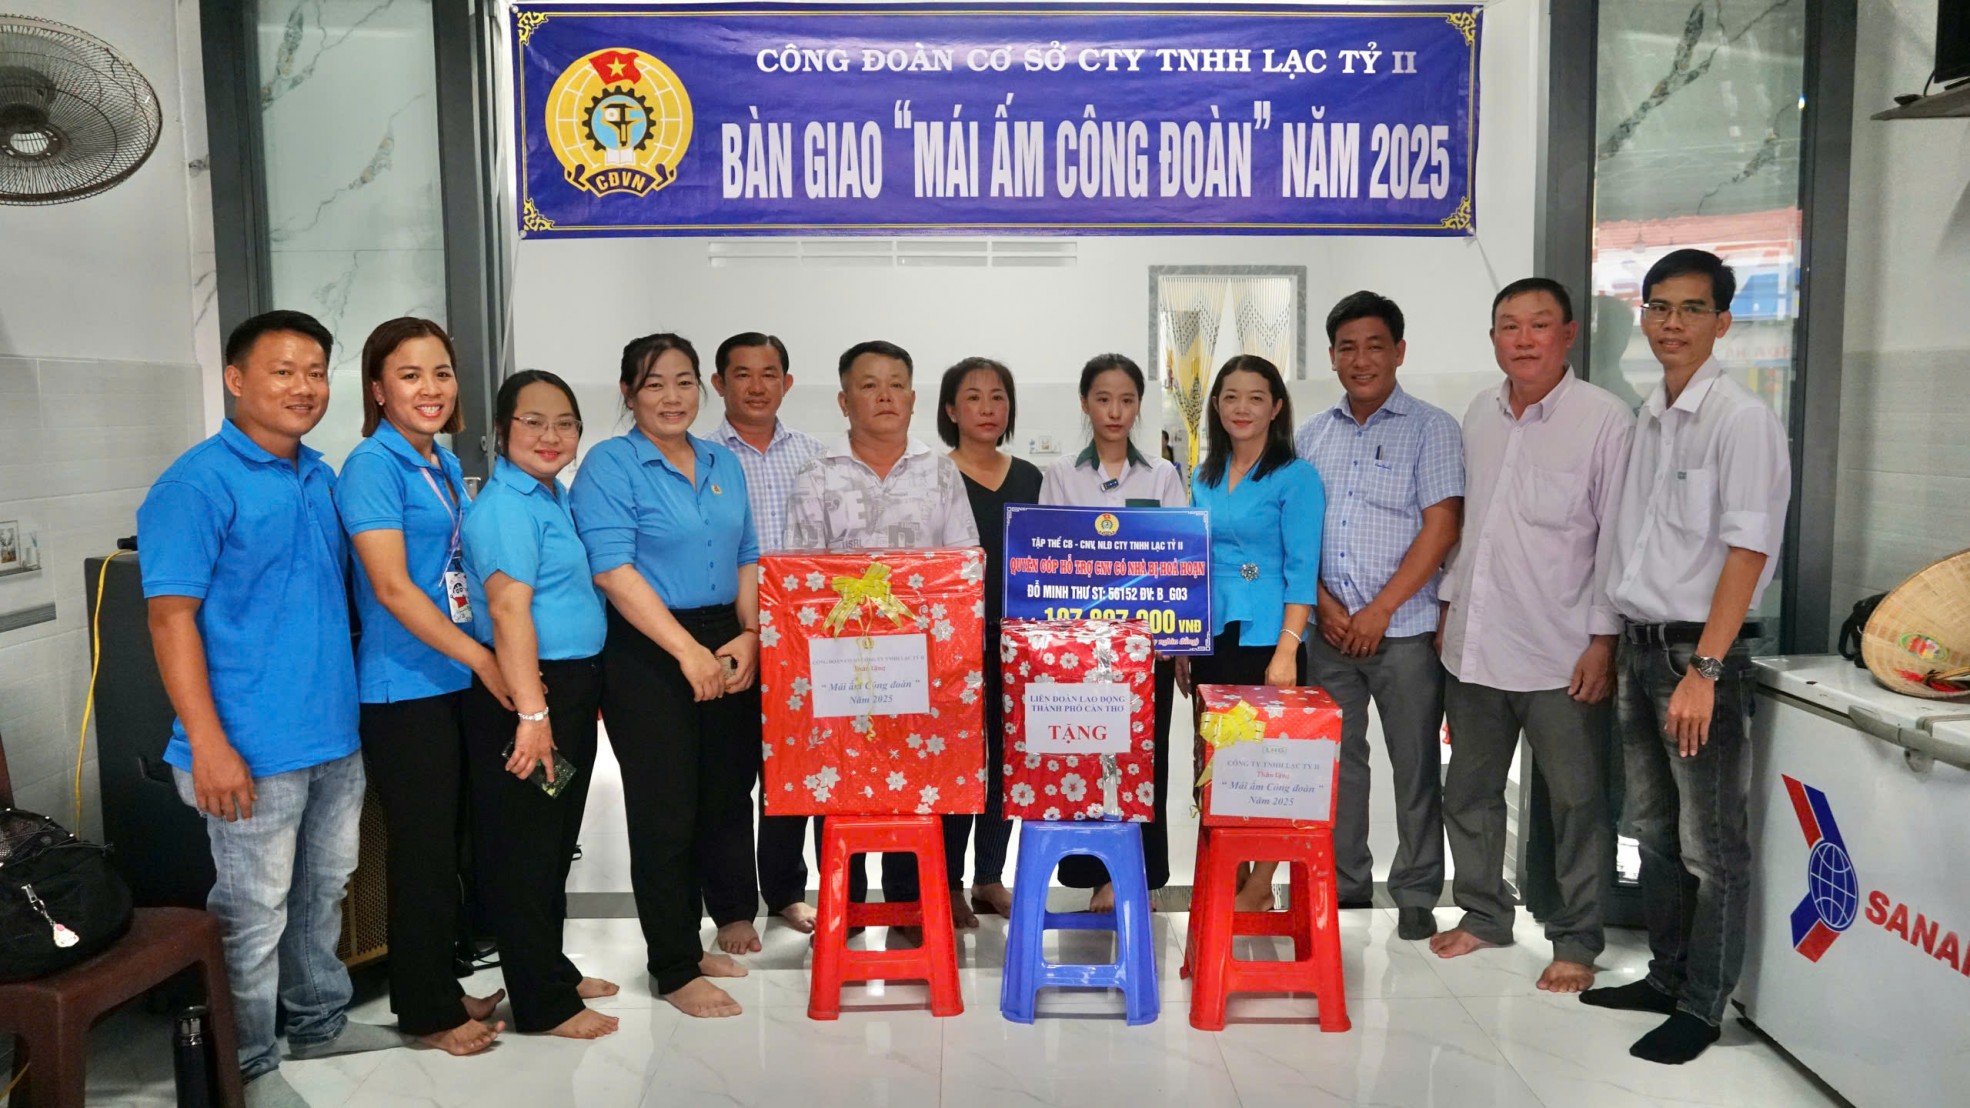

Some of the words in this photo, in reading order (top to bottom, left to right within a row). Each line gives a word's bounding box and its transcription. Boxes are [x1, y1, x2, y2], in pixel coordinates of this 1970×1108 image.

[757, 43, 850, 72] CÔNG
[861, 42, 953, 72] ĐOÀN
[967, 45, 1013, 72] CƠ
[1023, 40, 1067, 72] SỞ
[1078, 48, 1146, 72] CTY
[1156, 49, 1251, 73] TNHH
[1262, 49, 1327, 80] LẠC
[1338, 41, 1382, 74] TỶ
[1392, 51, 1418, 74] II
[721, 105, 793, 199] BÀN
[803, 121, 882, 199] GIAO
[990, 92, 1044, 198] ẤM
[1056, 104, 1148, 198] CÔNG
[1282, 105, 1360, 198] NĂM
[1369, 124, 1450, 200] 2025
[1031, 536, 1046, 549] TẬP
[1047, 536, 1062, 548] THỂ
[1063, 539, 1073, 549] CB
[1114, 541, 1128, 550] CTY
[1130, 541, 1150, 550] TNHH
[1151, 541, 1165, 552] LẠC
[1040, 555, 1059, 574] GÓP
[1074, 559, 1094, 578] TRỢ
[1094, 561, 1112, 575] CNV
[1113, 557, 1127, 575] CÓ
[1128, 558, 1147, 575] NHÀ
[1148, 561, 1159, 579] BỊ
[1180, 561, 1206, 579] HOẠN
[1027, 580, 1041, 598] ĐỖ
[1043, 585, 1069, 599] MINH
[1071, 585, 1091, 600] THƯ
[1092, 586, 1106, 600] ST:
[1108, 586, 1138, 601] 56152
[1157, 587, 1188, 602] B_G03
[1178, 619, 1202, 633] VNĐ
[848, 696, 870, 705] Năm
[872, 694, 893, 704] 2025
[1079, 695, 1099, 703] LAO
[1048, 723, 1108, 744] TẶNG
[1247, 795, 1270, 806] Năm
[1272, 797, 1295, 806] 2025
